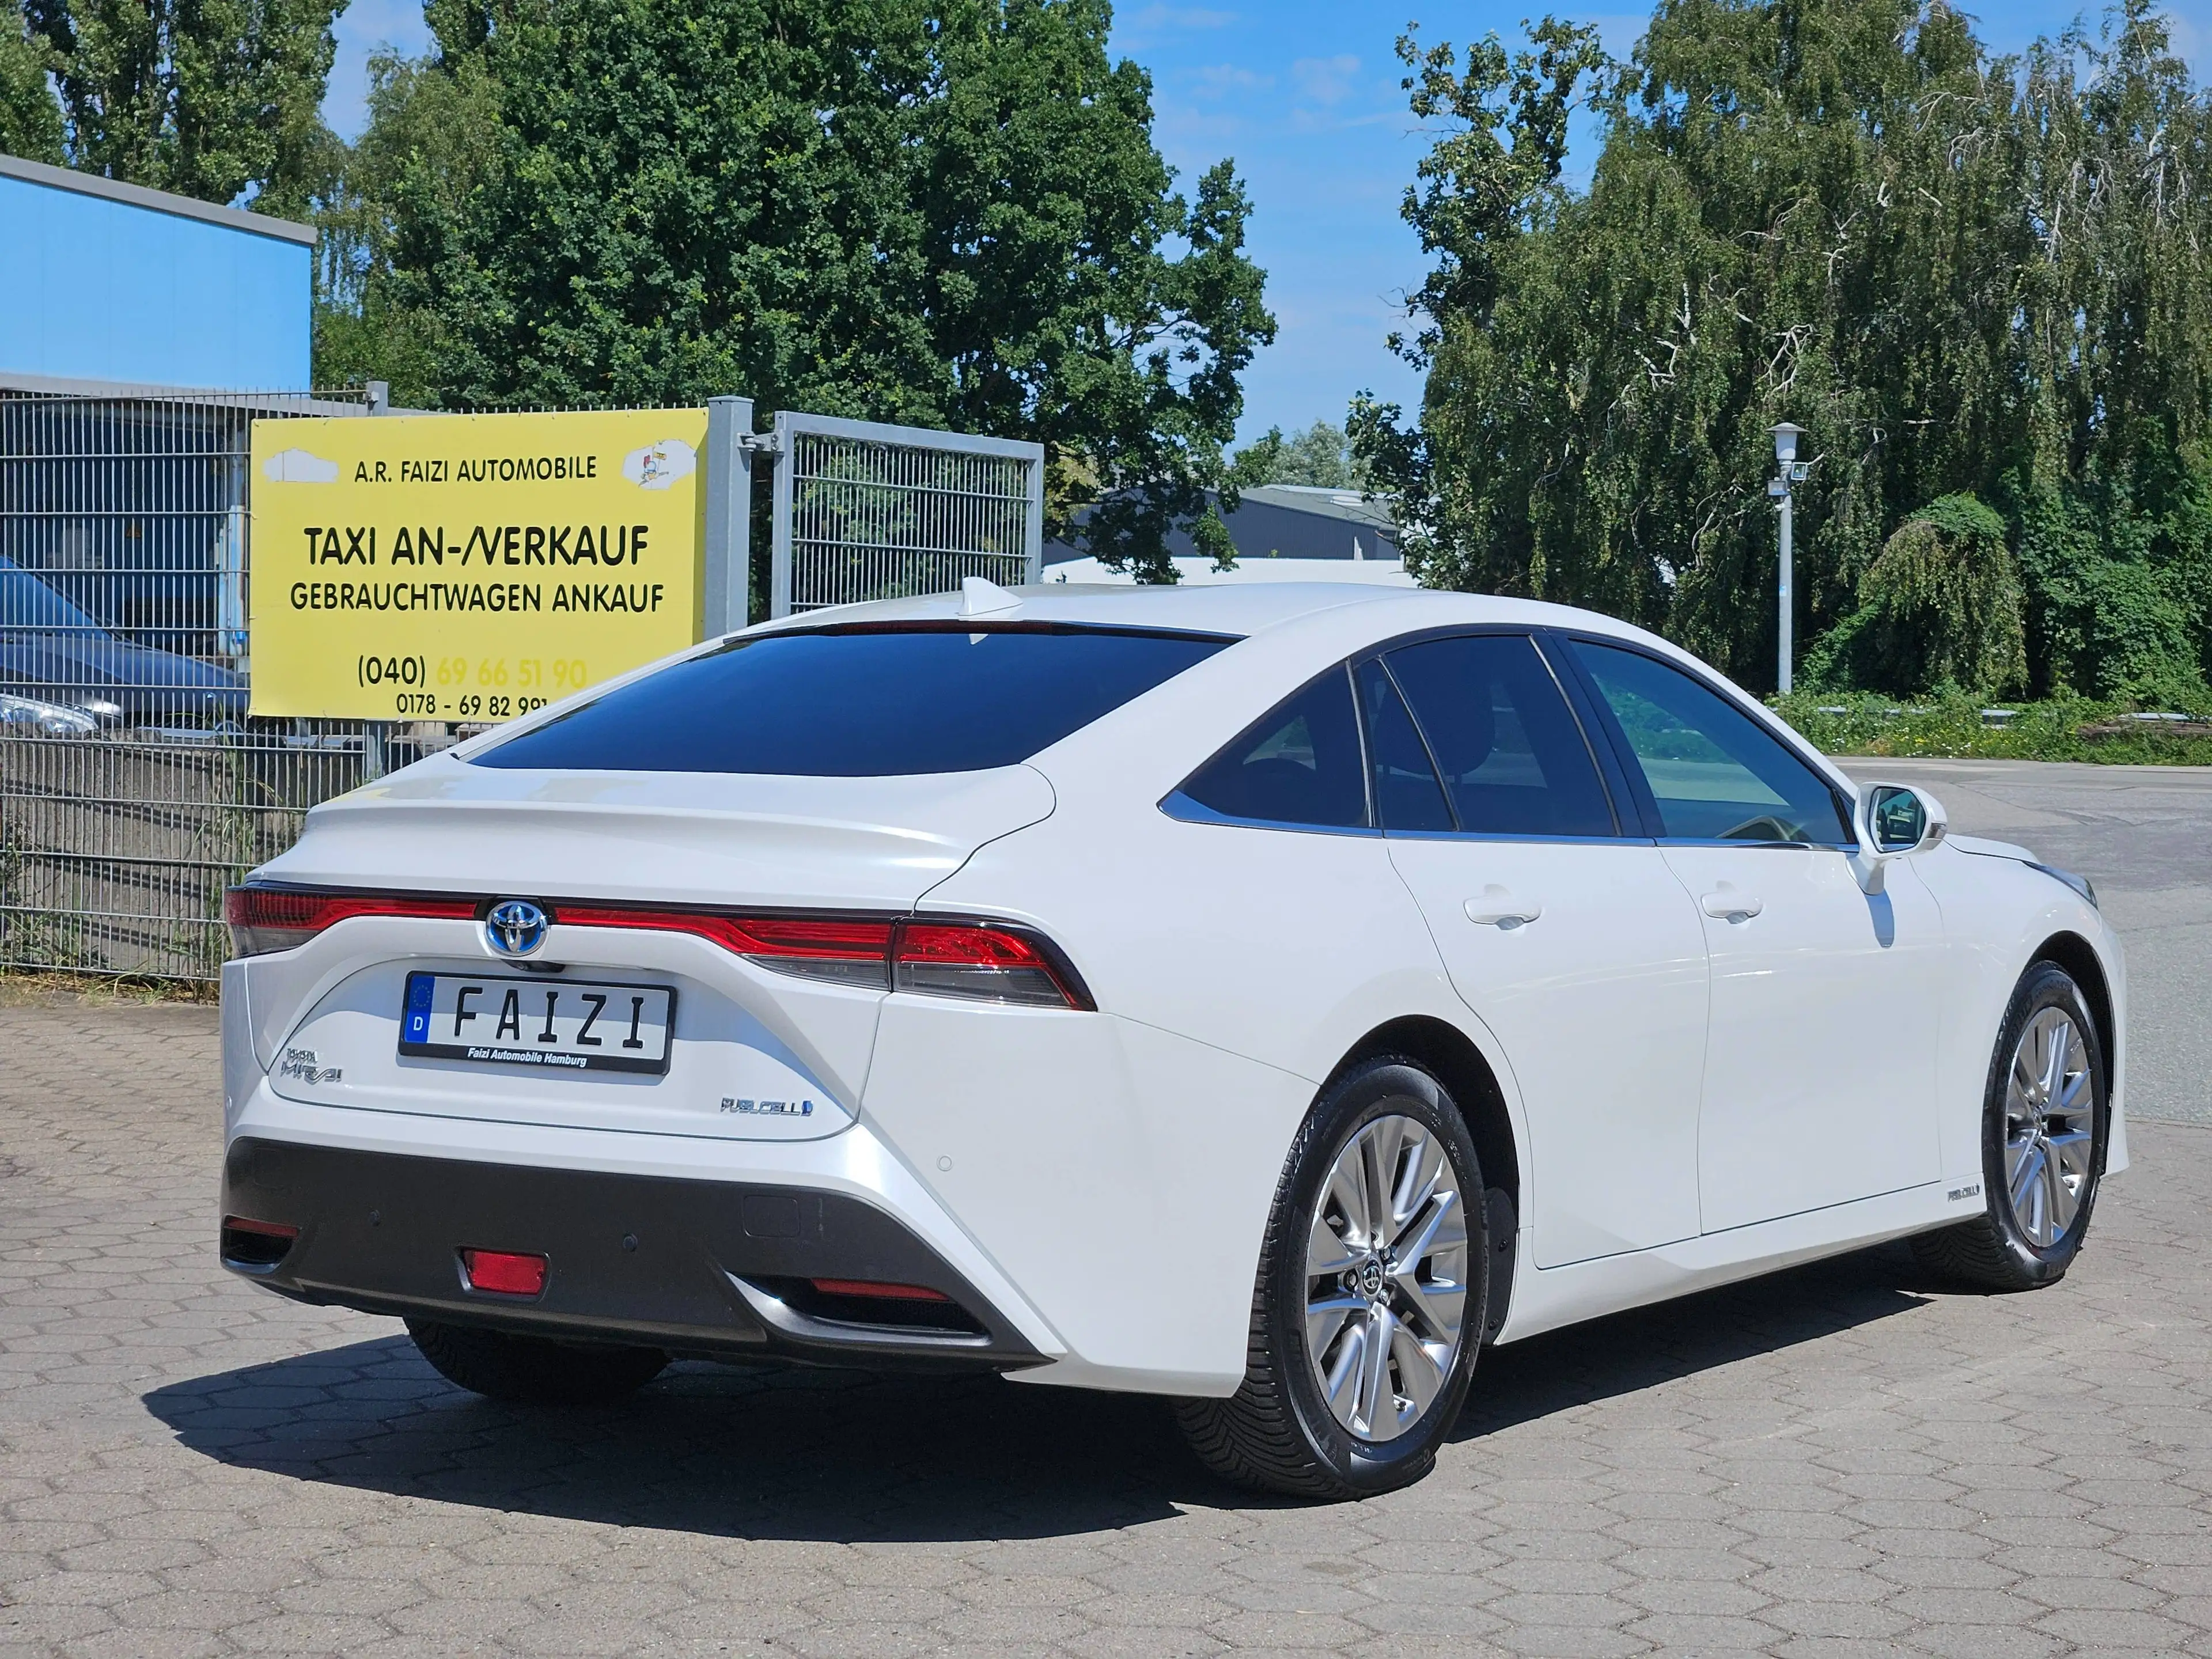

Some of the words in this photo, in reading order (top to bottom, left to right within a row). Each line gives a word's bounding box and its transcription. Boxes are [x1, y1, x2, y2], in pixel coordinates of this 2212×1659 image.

[355, 461, 392, 482] A.R.
[401, 460, 448, 482] FAIZI
[457, 456, 597, 482] AUTOMOBILE
[304, 527, 376, 565] TAXI
[290, 582, 540, 612] GEBRAUCHTWAGEN
[552, 584, 664, 612] ANKAUF
[358, 655, 425, 688] (040)
[437, 657, 467, 686] 69
[478, 658, 509, 687] 66
[518, 660, 541, 687] 51
[553, 660, 588, 688] 90
[396, 694, 435, 714] 0178
[460, 695, 481, 715] 69
[489, 696, 510, 716] 82
[413, 1016, 423, 1031] D
[454, 986, 644, 1049] FAIZI
[468, 1047, 490, 1058] Faizi
[491, 1050, 542, 1063] Automobile
[544, 1053, 588, 1067] Hamburg
